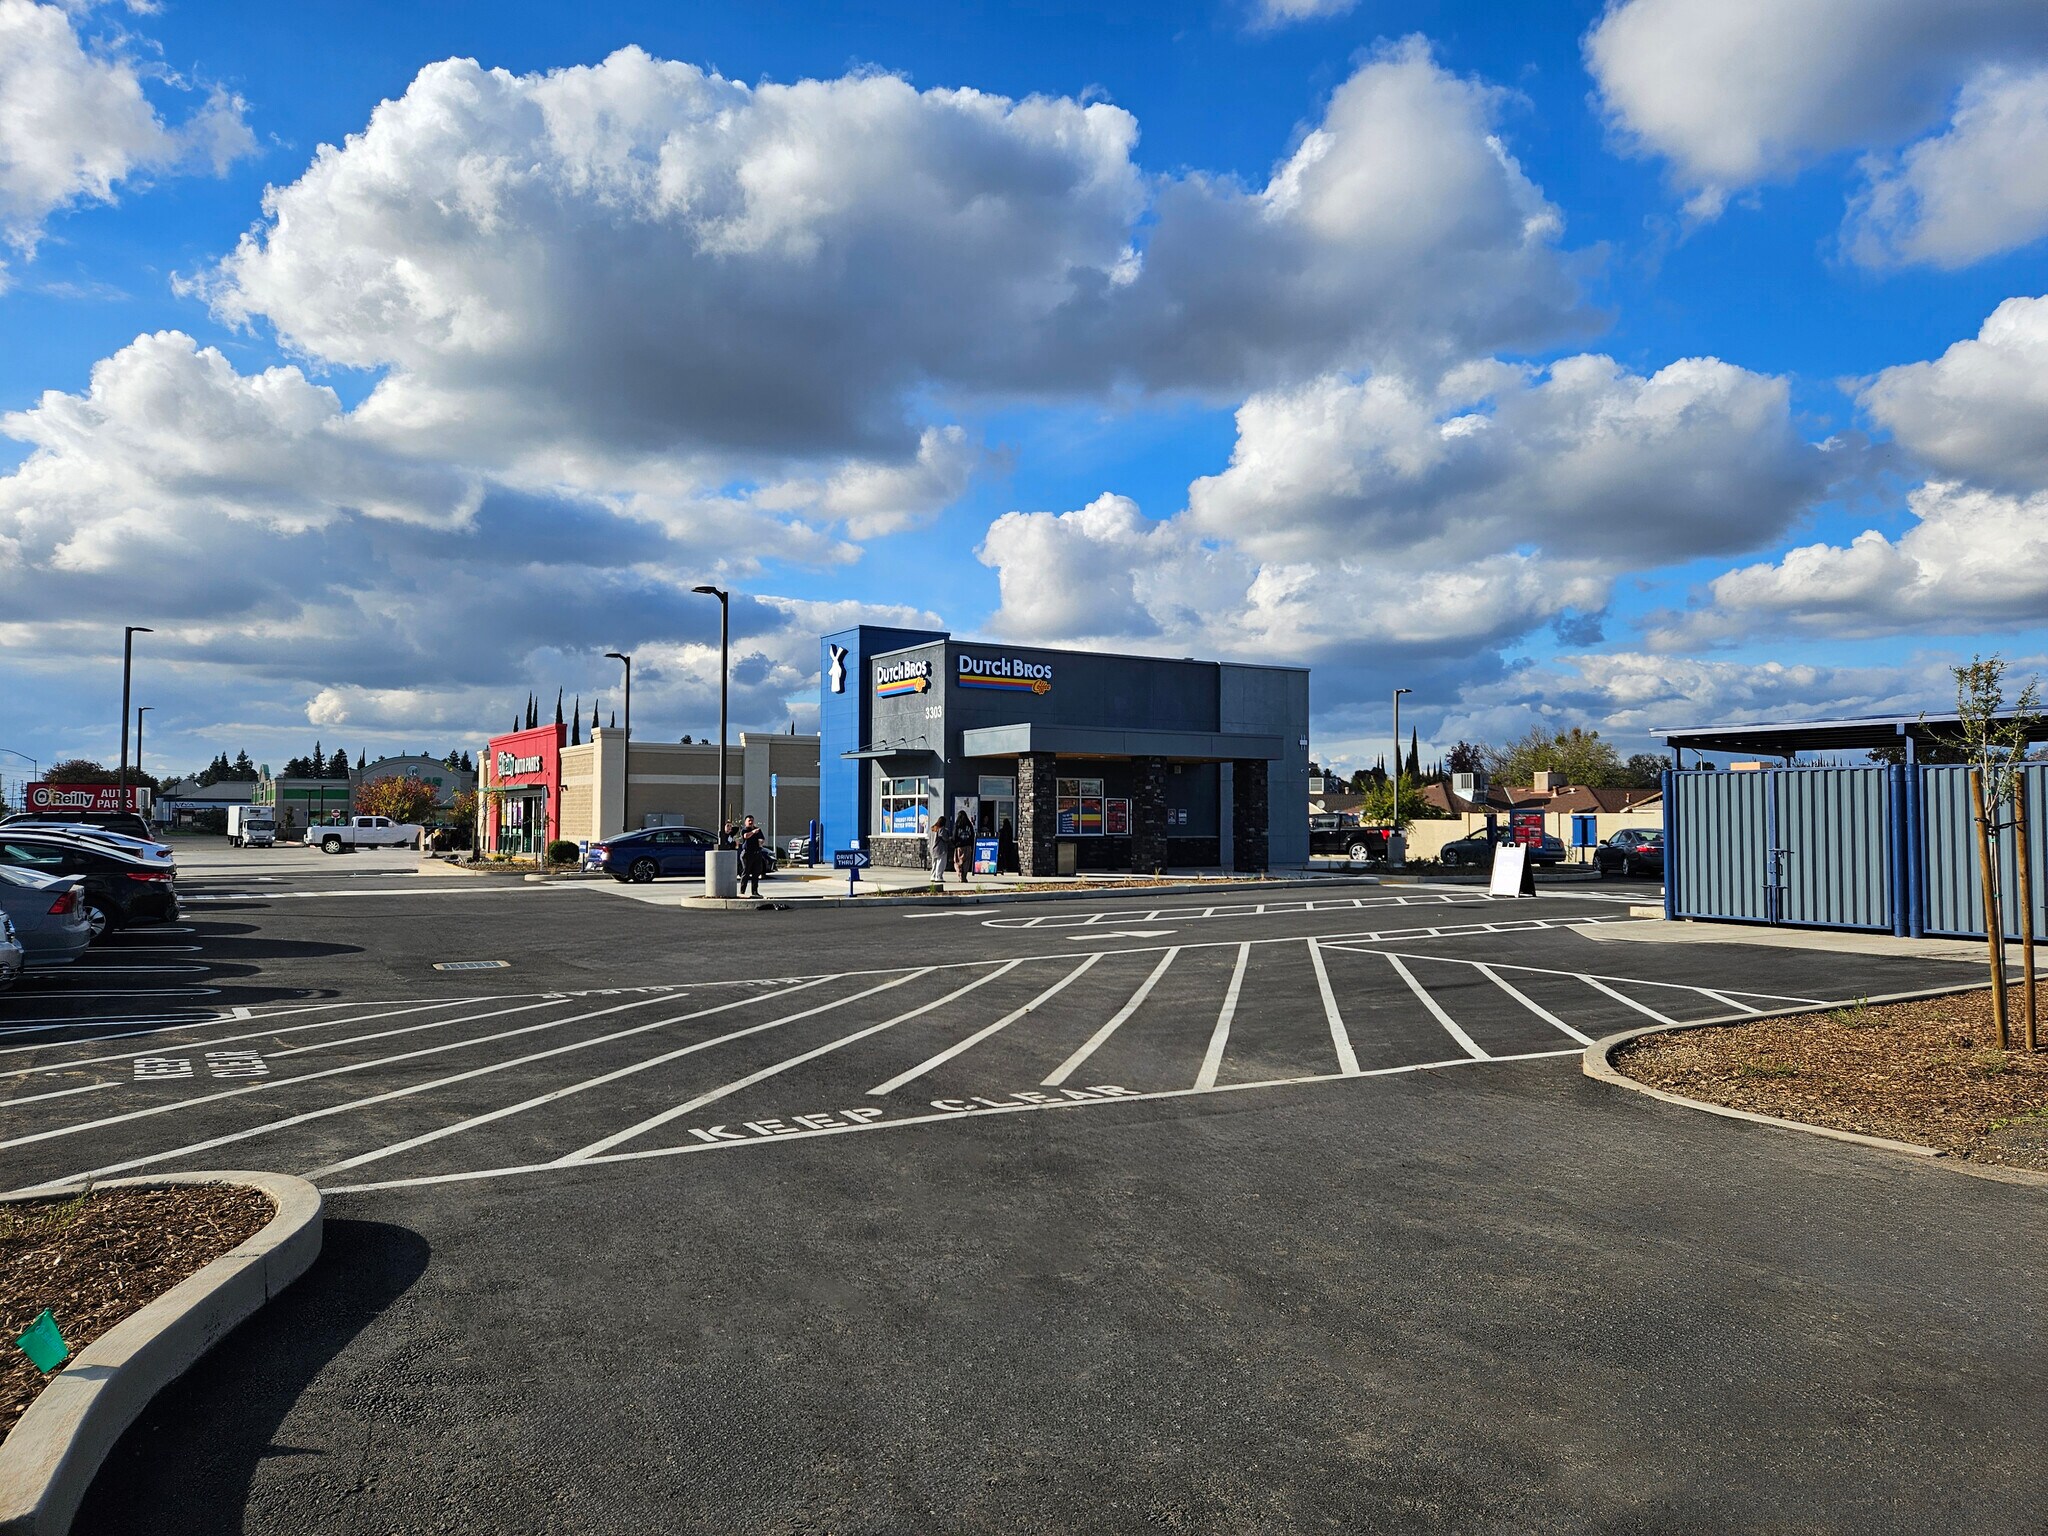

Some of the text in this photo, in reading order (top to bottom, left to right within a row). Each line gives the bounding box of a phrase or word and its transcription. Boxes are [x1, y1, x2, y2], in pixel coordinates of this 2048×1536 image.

[877, 660, 927, 684] DUTCH BROS
[959, 655, 1052, 679] DUTCH BROS
[925, 705, 942, 719] 3303
[97, 799, 133, 808] PARS
[133, 1058, 195, 1081] KEEP
[204, 1049, 271, 1078] CLEAR
[687, 1085, 1142, 1142] KEEP CLEAR
